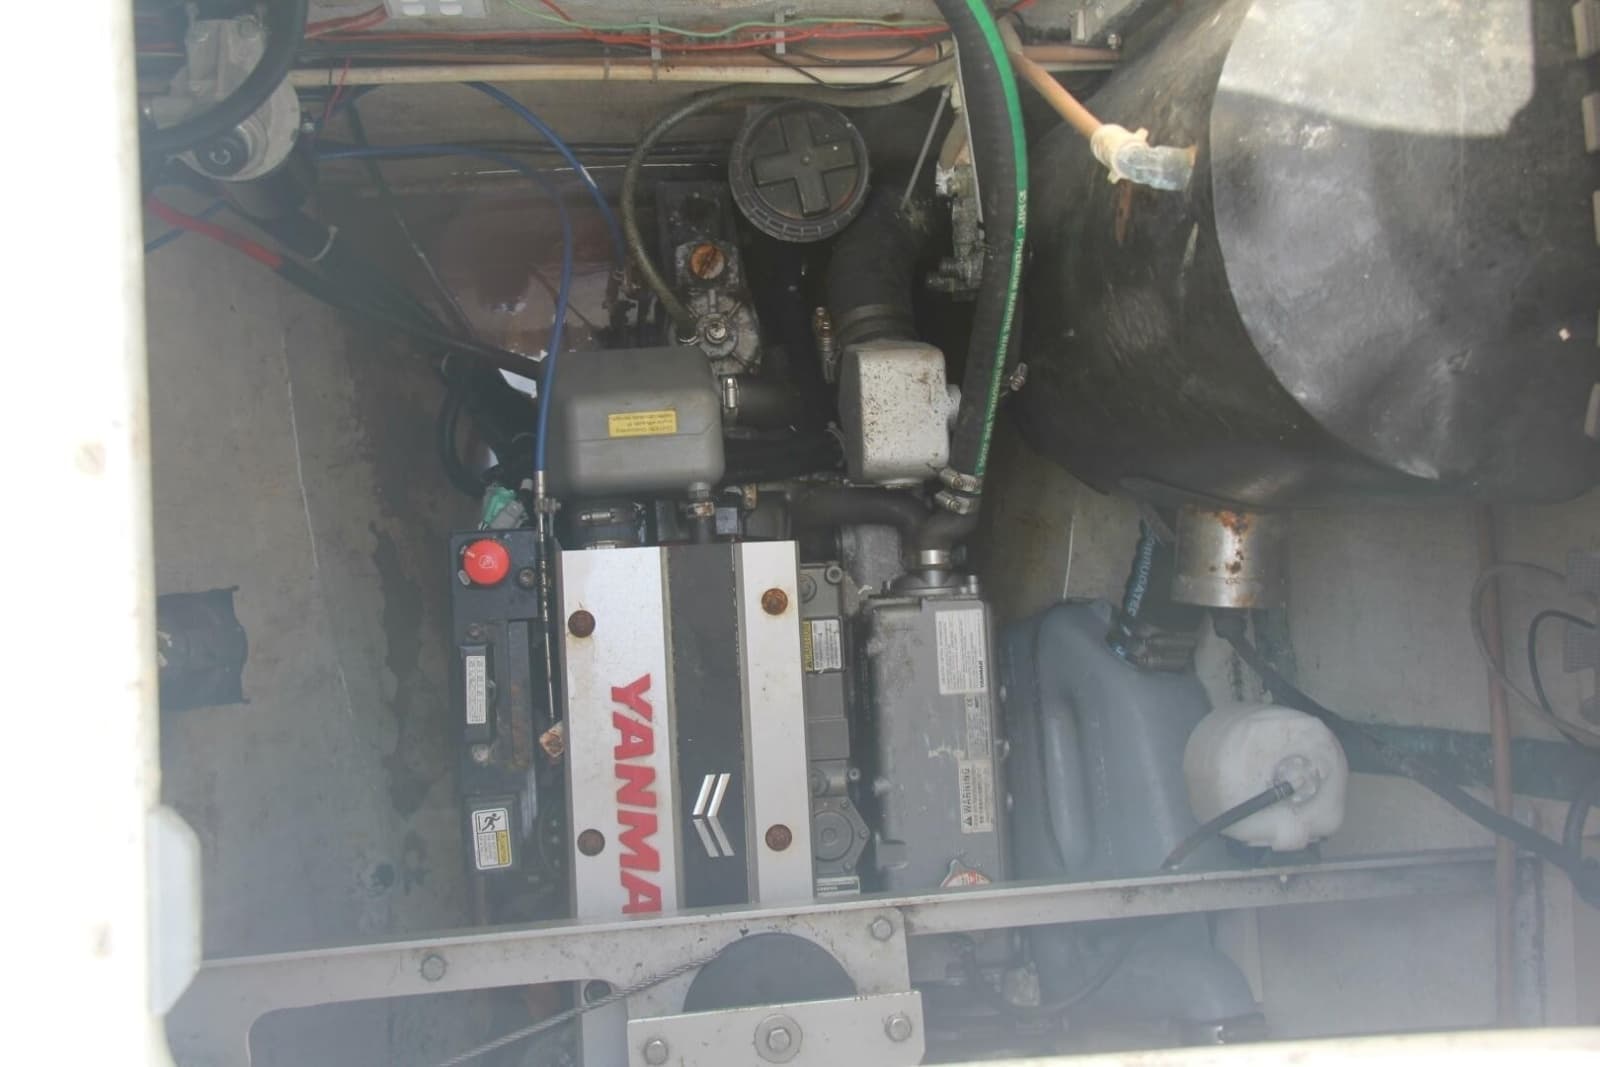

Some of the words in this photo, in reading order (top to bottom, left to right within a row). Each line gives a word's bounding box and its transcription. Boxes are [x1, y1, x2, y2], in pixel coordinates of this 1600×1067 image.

[1012, 238, 1023, 290] PREMIUM
[610, 673, 662, 914] YANMA
[961, 768, 972, 814] WARNING
